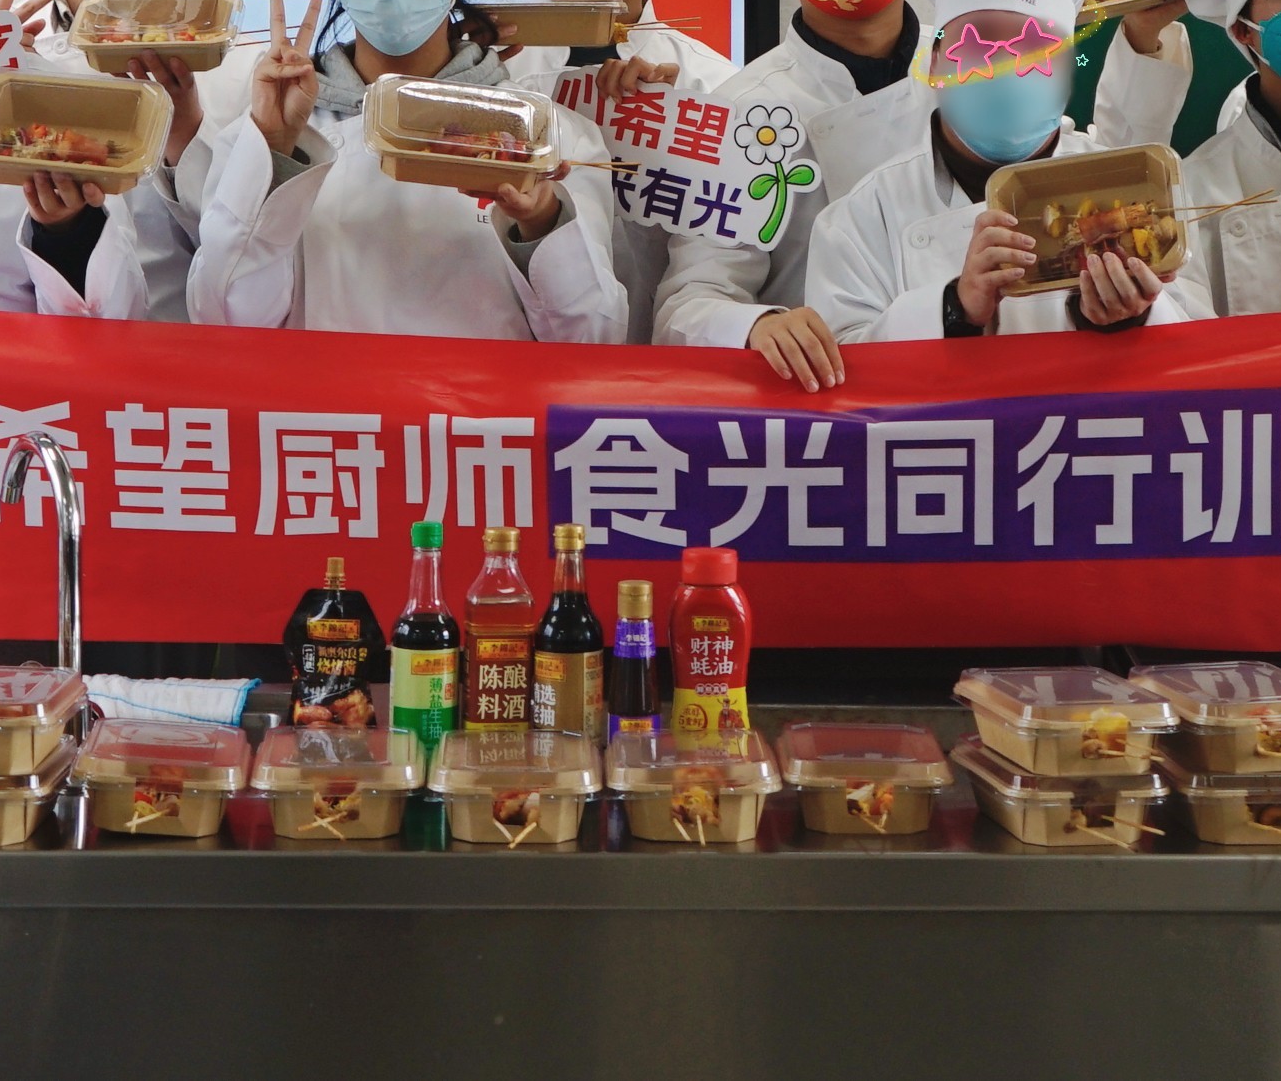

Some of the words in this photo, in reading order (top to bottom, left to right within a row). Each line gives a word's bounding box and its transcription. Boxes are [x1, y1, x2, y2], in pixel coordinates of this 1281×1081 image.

[690, 635, 735, 657] 财神
[478, 663, 528, 691] 陈酿
[689, 655, 734, 676] 蚝油
[430, 677, 443, 738] 薄盐生抽
[477, 693, 527, 720] 料酒
